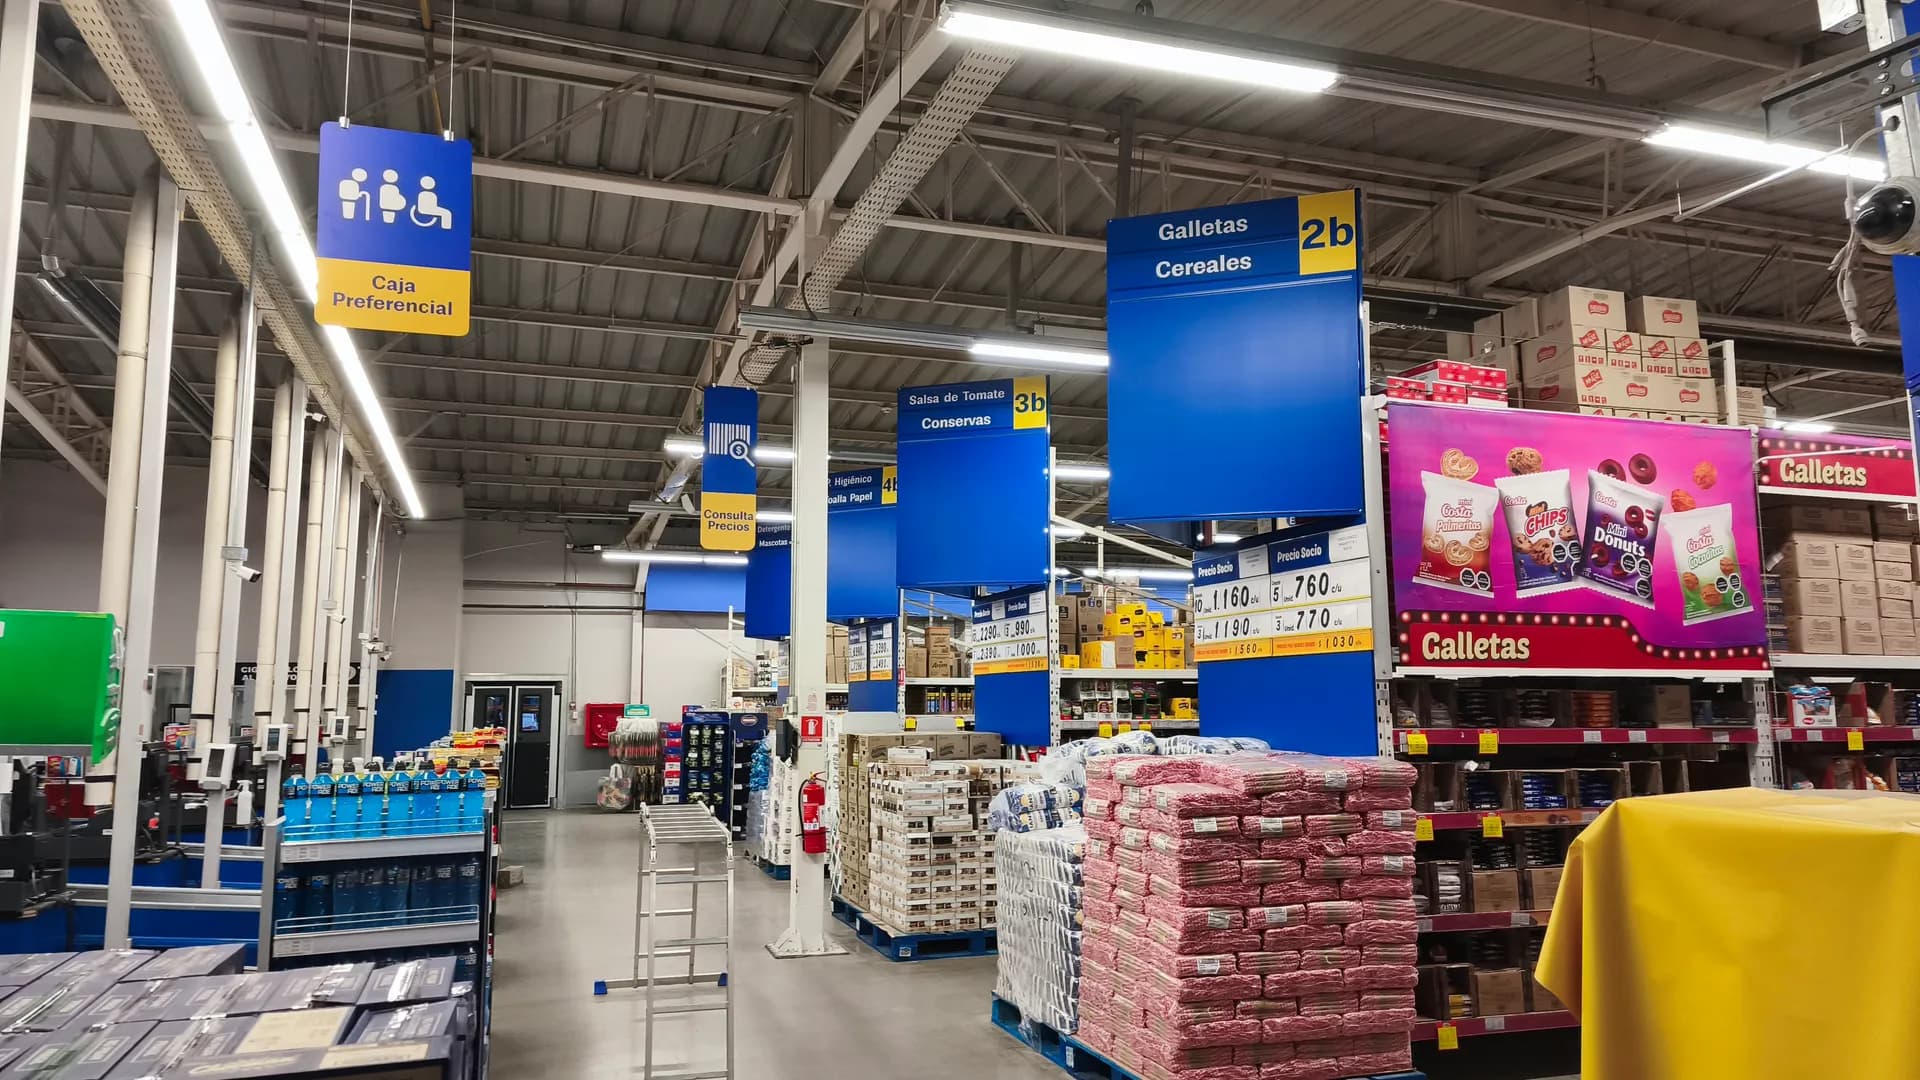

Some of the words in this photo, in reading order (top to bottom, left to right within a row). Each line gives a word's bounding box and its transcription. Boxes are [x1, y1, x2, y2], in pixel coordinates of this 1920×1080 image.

[1158, 217, 1249, 241] Galletas
[1301, 216, 1354, 250] 2b
[1155, 255, 1252, 279] Cereales
[372, 275, 416, 295] Caja
[332, 291, 453, 316] Preferencial
[909, 394, 940, 406] Salsa
[943, 392, 959, 403] de
[962, 389, 1005, 401] Tomate
[1014, 392, 1046, 413] 3b
[921, 415, 992, 429] Conservas
[1780, 457, 1868, 487] Galletas
[849, 491, 873, 503] Papel
[703, 509, 754, 521] Consulta
[1441, 503, 1473, 518] Costa
[708, 520, 750, 532] Precios
[1436, 520, 1482, 533] Palmeritas
[1525, 508, 1568, 536] CHIPS
[1606, 522, 1627, 538] Mini
[759, 539, 788, 547] Mascotas
[1593, 526, 1646, 557] Donuts
[1687, 535, 1714, 553] Costa
[1276, 549, 1300, 563] Precio
[1300, 543, 1322, 559] Socio
[1198, 564, 1217, 578] Precio
[1217, 561, 1234, 574] Socio
[1272, 587, 1279, 602] 5
[1295, 572, 1329, 599] 760
[1015, 619, 1030, 636] 990
[1275, 619, 1281, 632] 3
[1296, 608, 1330, 631] 770
[1016, 641, 1036, 657] 1000
[1235, 643, 1257, 656] 1560
[1326, 635, 1354, 649] 1030
[1421, 631, 1530, 660] Galletas
